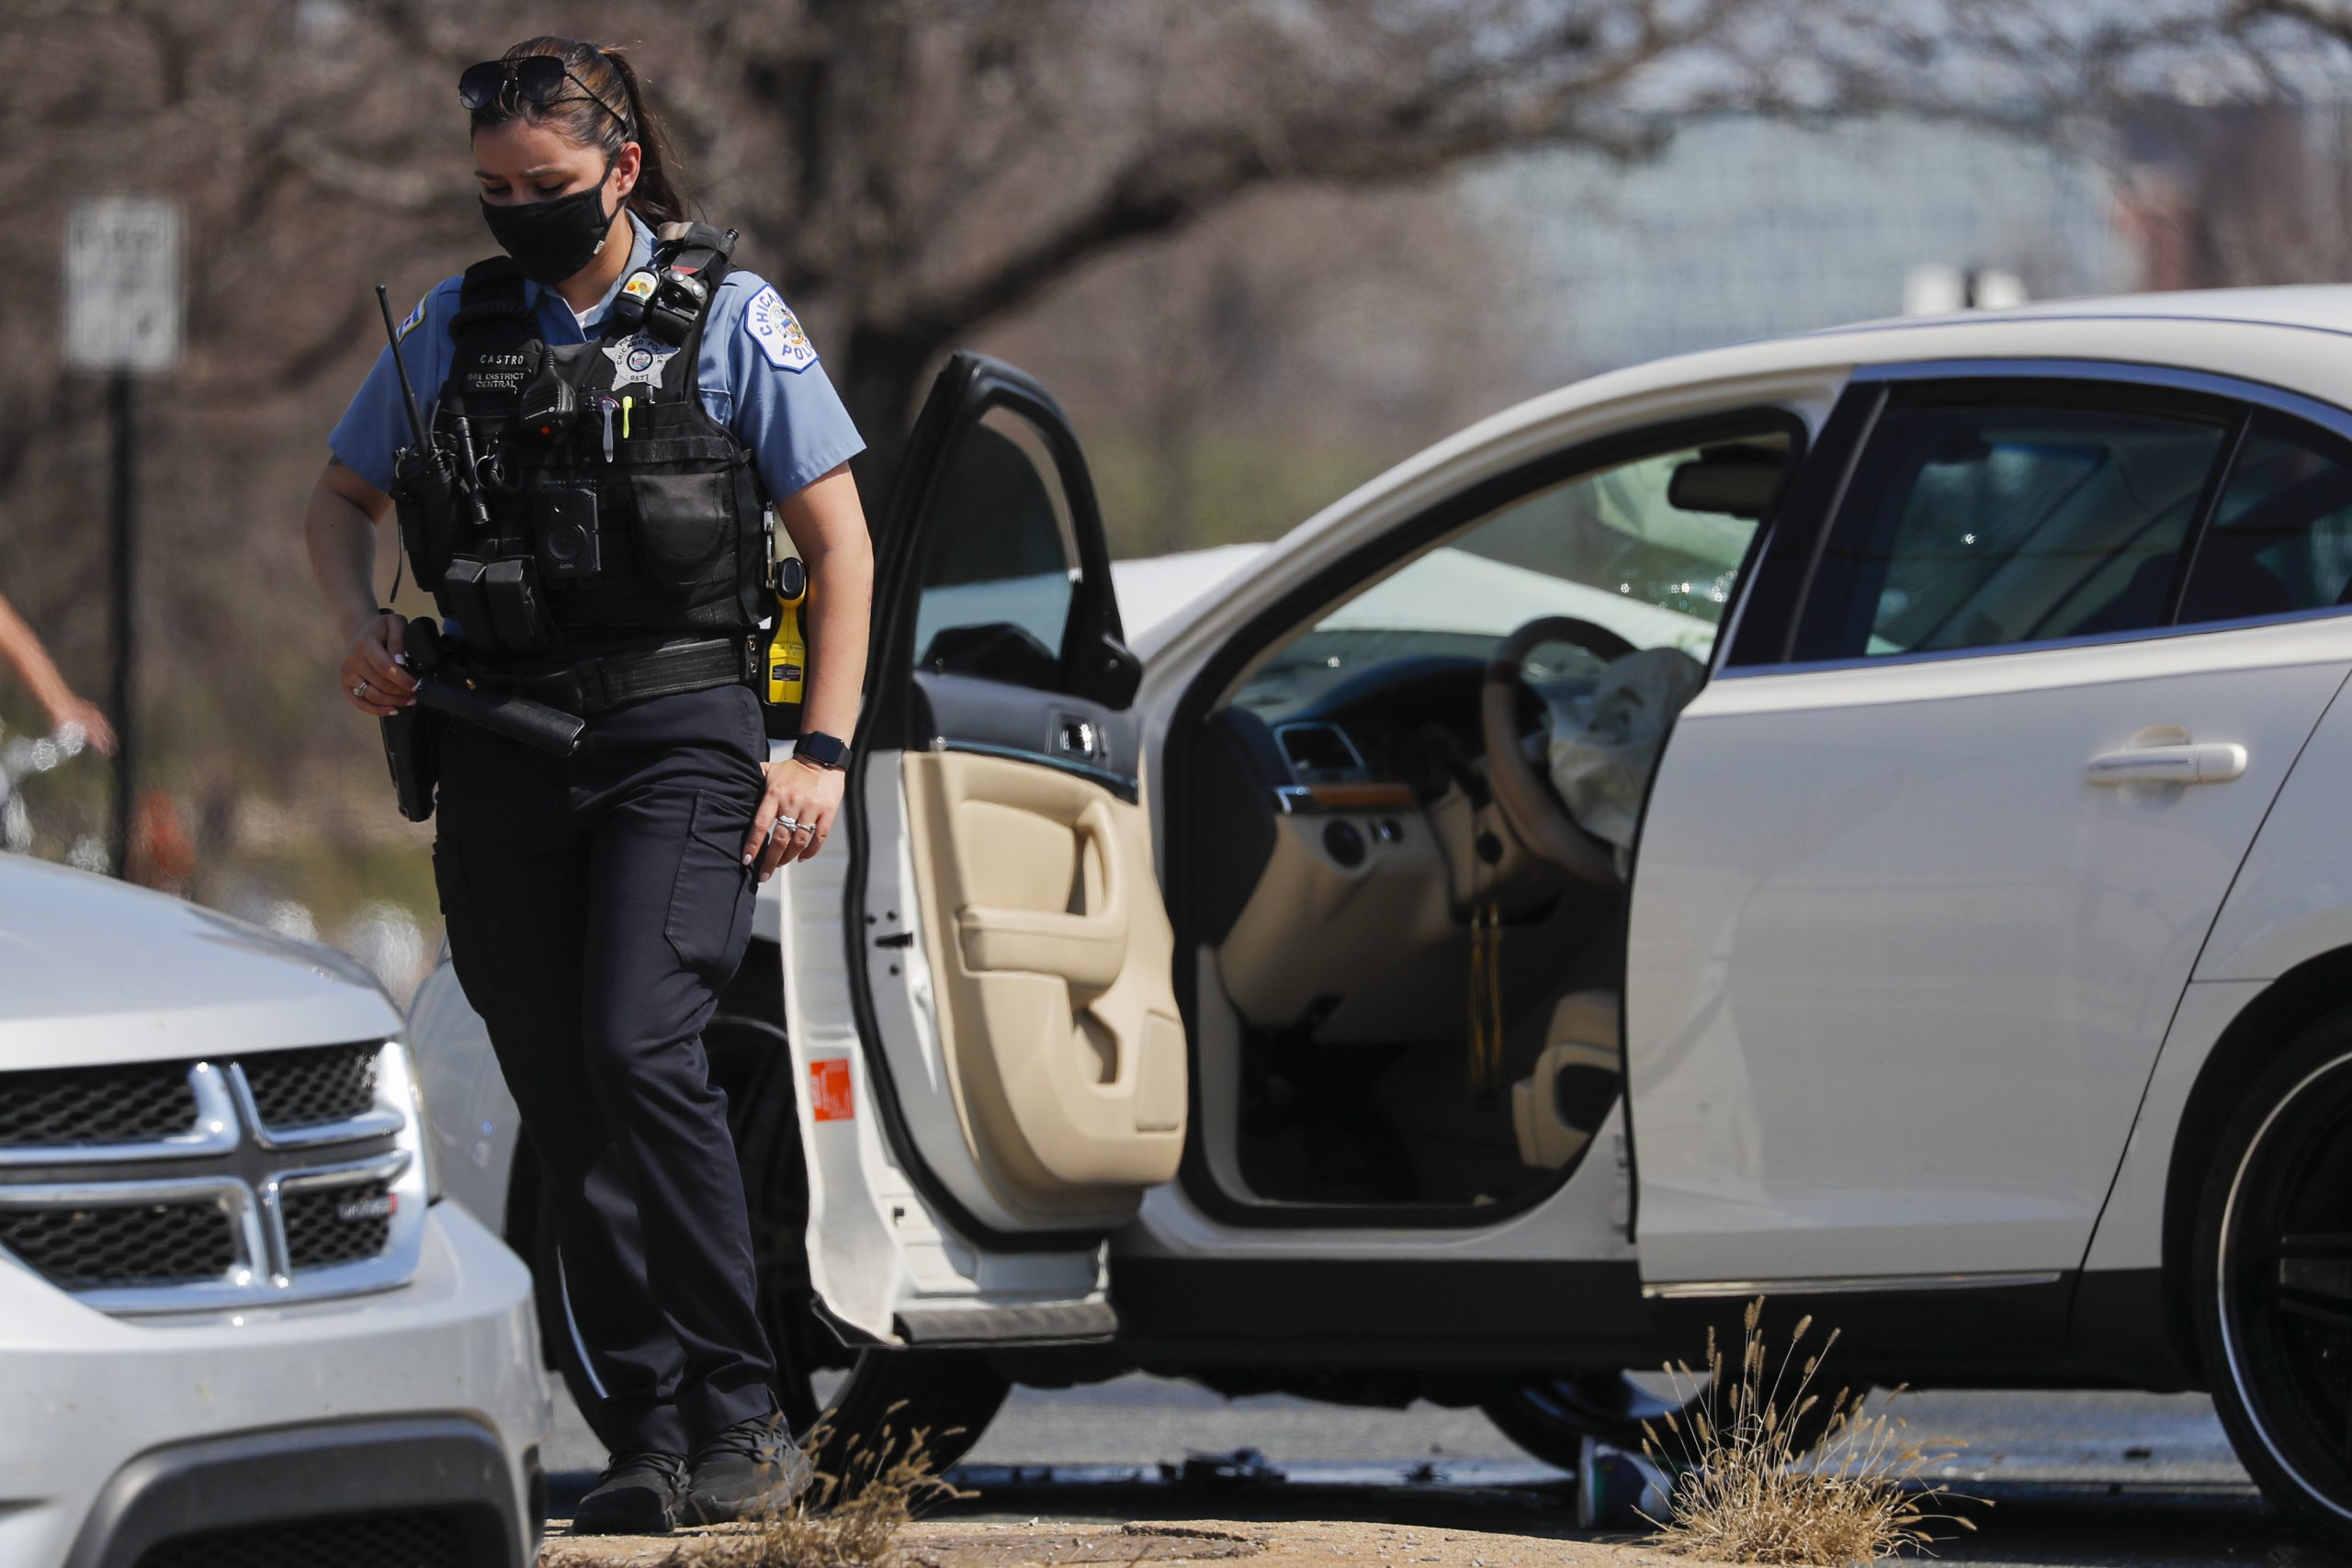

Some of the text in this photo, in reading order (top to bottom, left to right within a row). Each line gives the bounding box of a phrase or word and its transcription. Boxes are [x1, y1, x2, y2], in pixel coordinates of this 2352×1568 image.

[616, 339, 643, 365] CHICAGO
[648, 341, 663, 364] POLICE
[480, 354, 524, 365] CASTRO
[485, 372, 525, 380] DISTRICT
